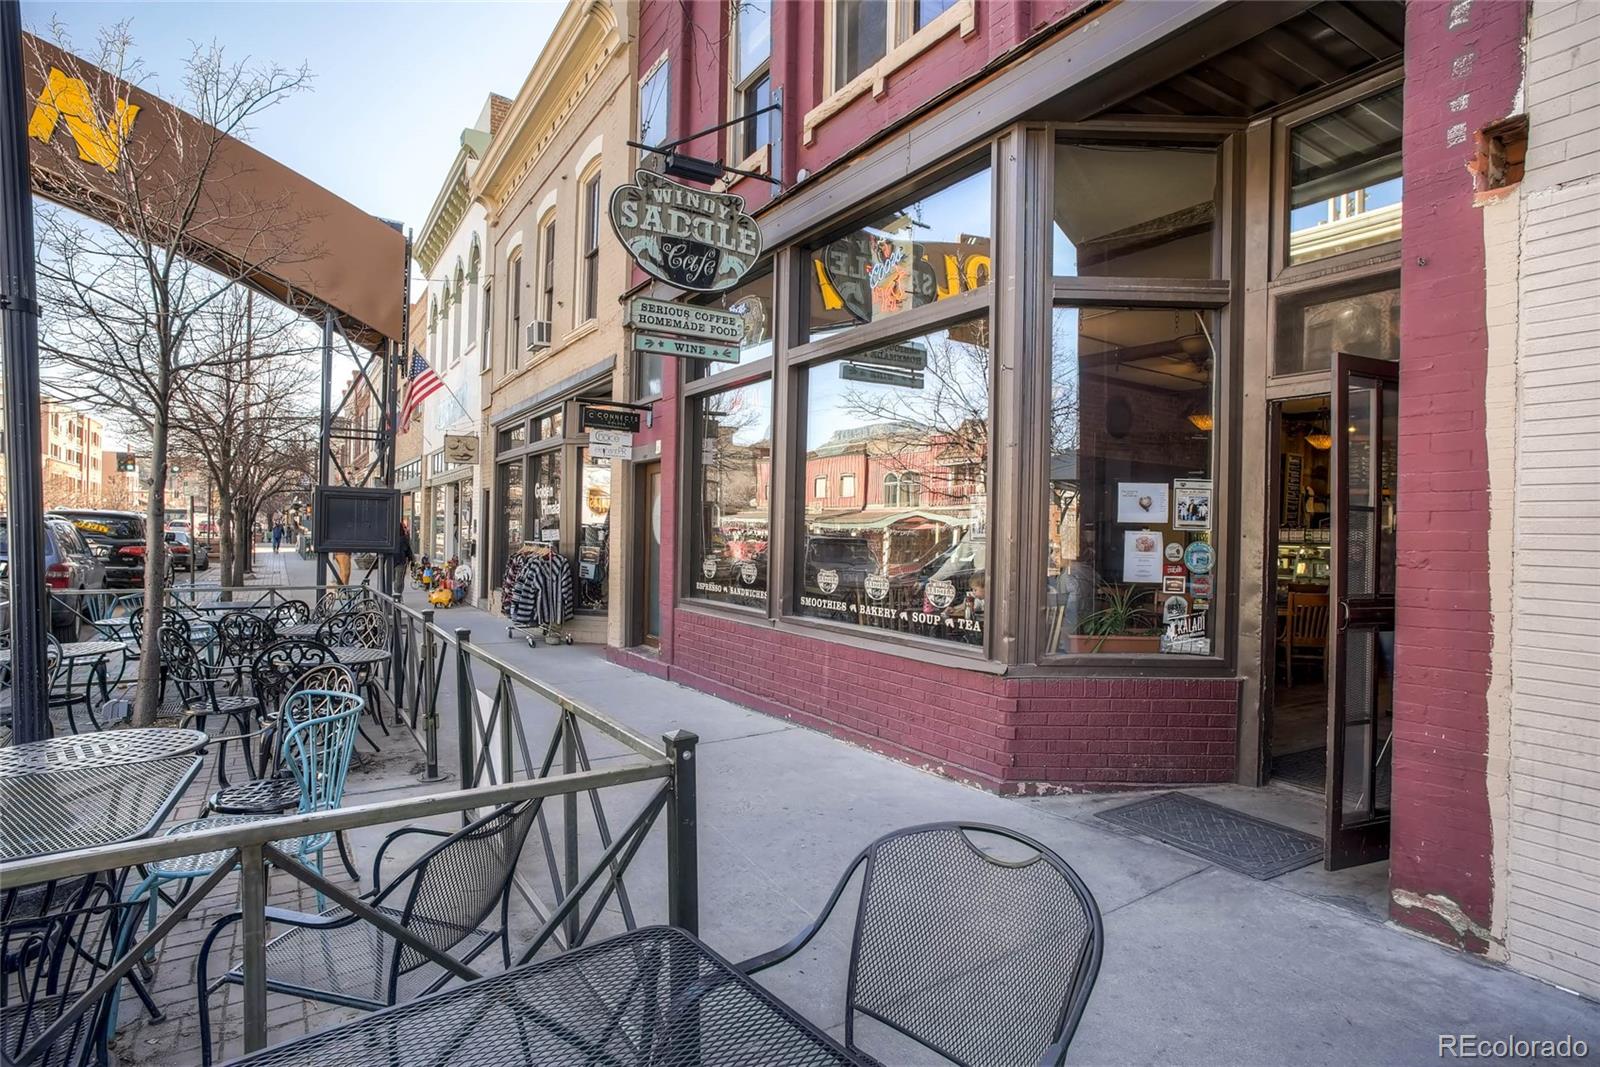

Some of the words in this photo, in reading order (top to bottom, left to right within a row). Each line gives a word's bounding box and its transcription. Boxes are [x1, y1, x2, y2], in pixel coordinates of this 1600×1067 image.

[652, 187, 731, 220] WINDY
[620, 200, 756, 256] SADDLE
[641, 303, 690, 319] SERIOUS
[638, 314, 705, 333] HOMEMADE
[710, 325, 738, 337] FOOD
[674, 342, 706, 355] WINE
[800, 596, 847, 612] SMOOTHIES
[859, 604, 897, 619] BAKERY
[912, 612, 942, 626] SOUP
[957, 618, 982, 632] TEA
